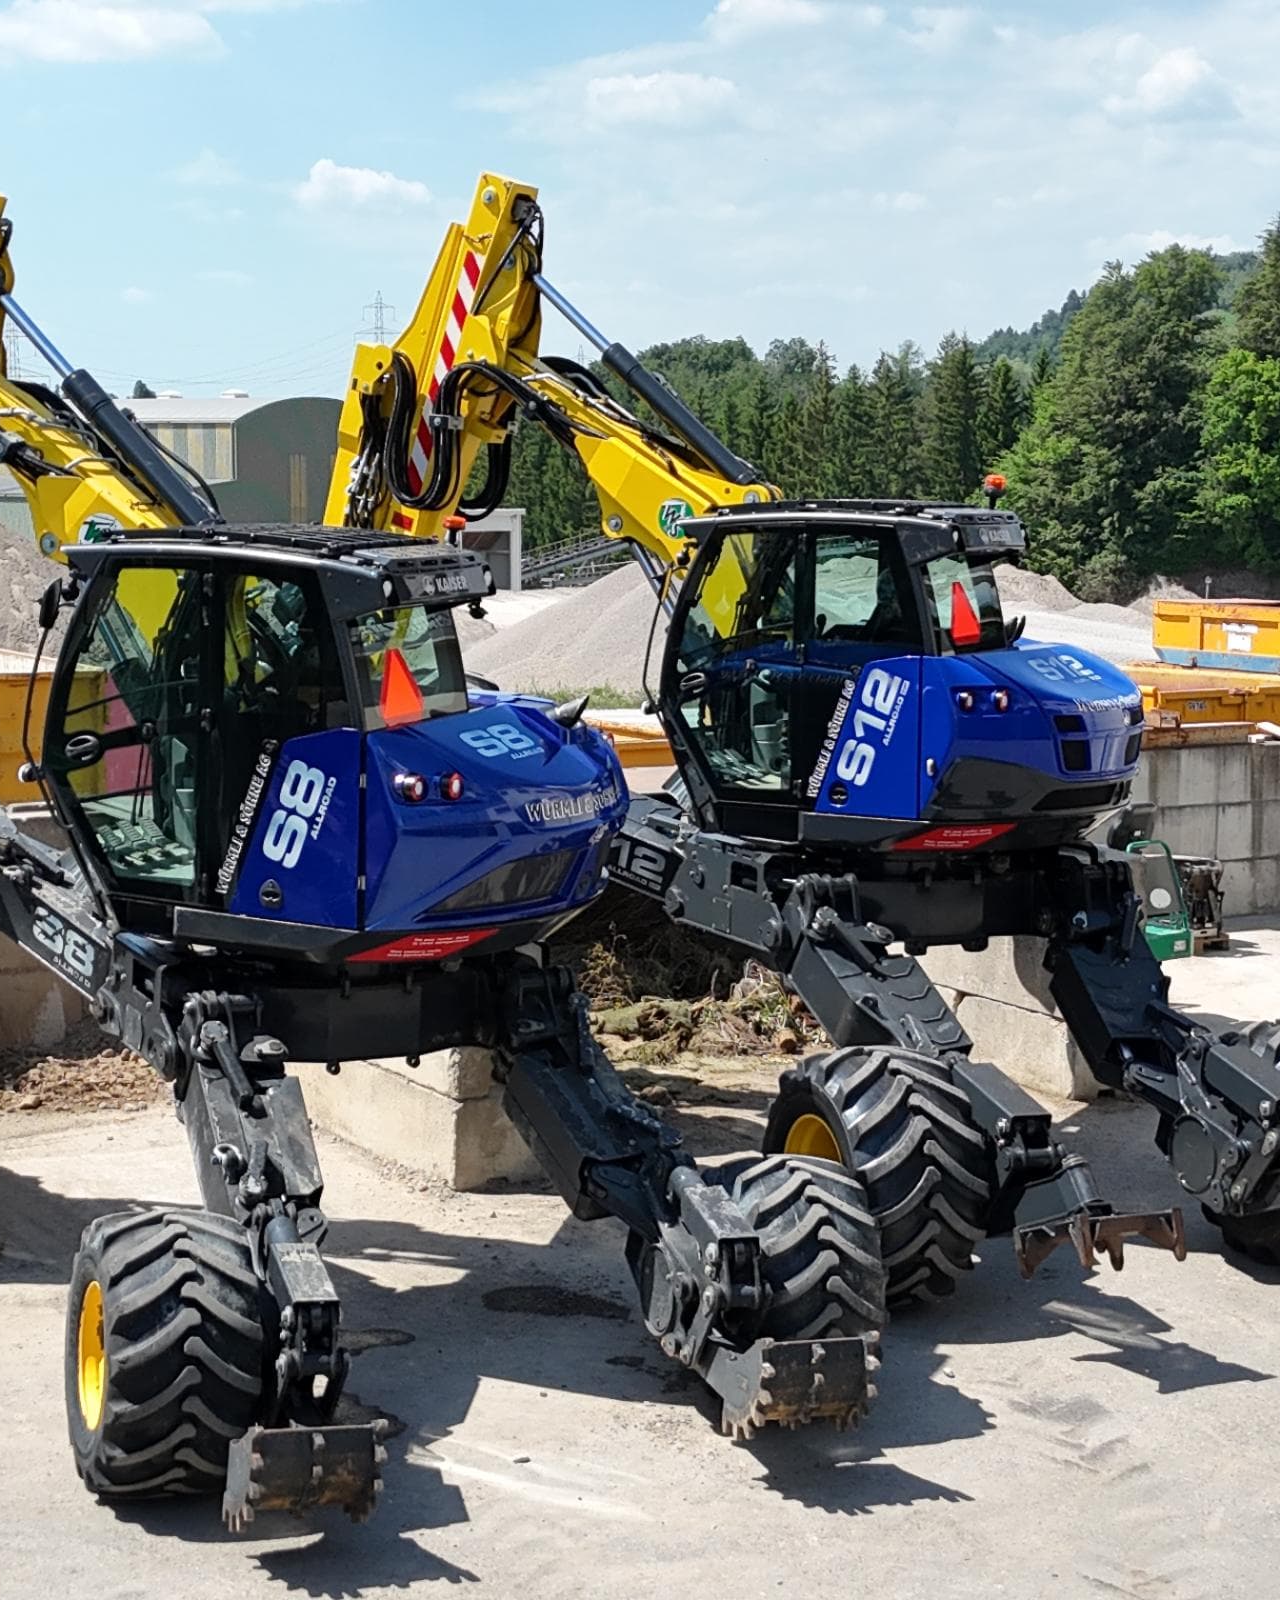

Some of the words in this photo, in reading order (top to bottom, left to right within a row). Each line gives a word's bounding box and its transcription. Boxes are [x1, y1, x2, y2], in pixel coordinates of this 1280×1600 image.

[435, 575, 467, 593] KAISER
[1027, 655, 1095, 681] S12
[459, 723, 535, 757] S8
[837, 668, 902, 786] S12
[882, 696, 905, 746] ALLROAD
[235, 824, 249, 838] &
[256, 753, 272, 777] AG
[262, 759, 325, 869] S8
[310, 776, 337, 840] ALLROAD
